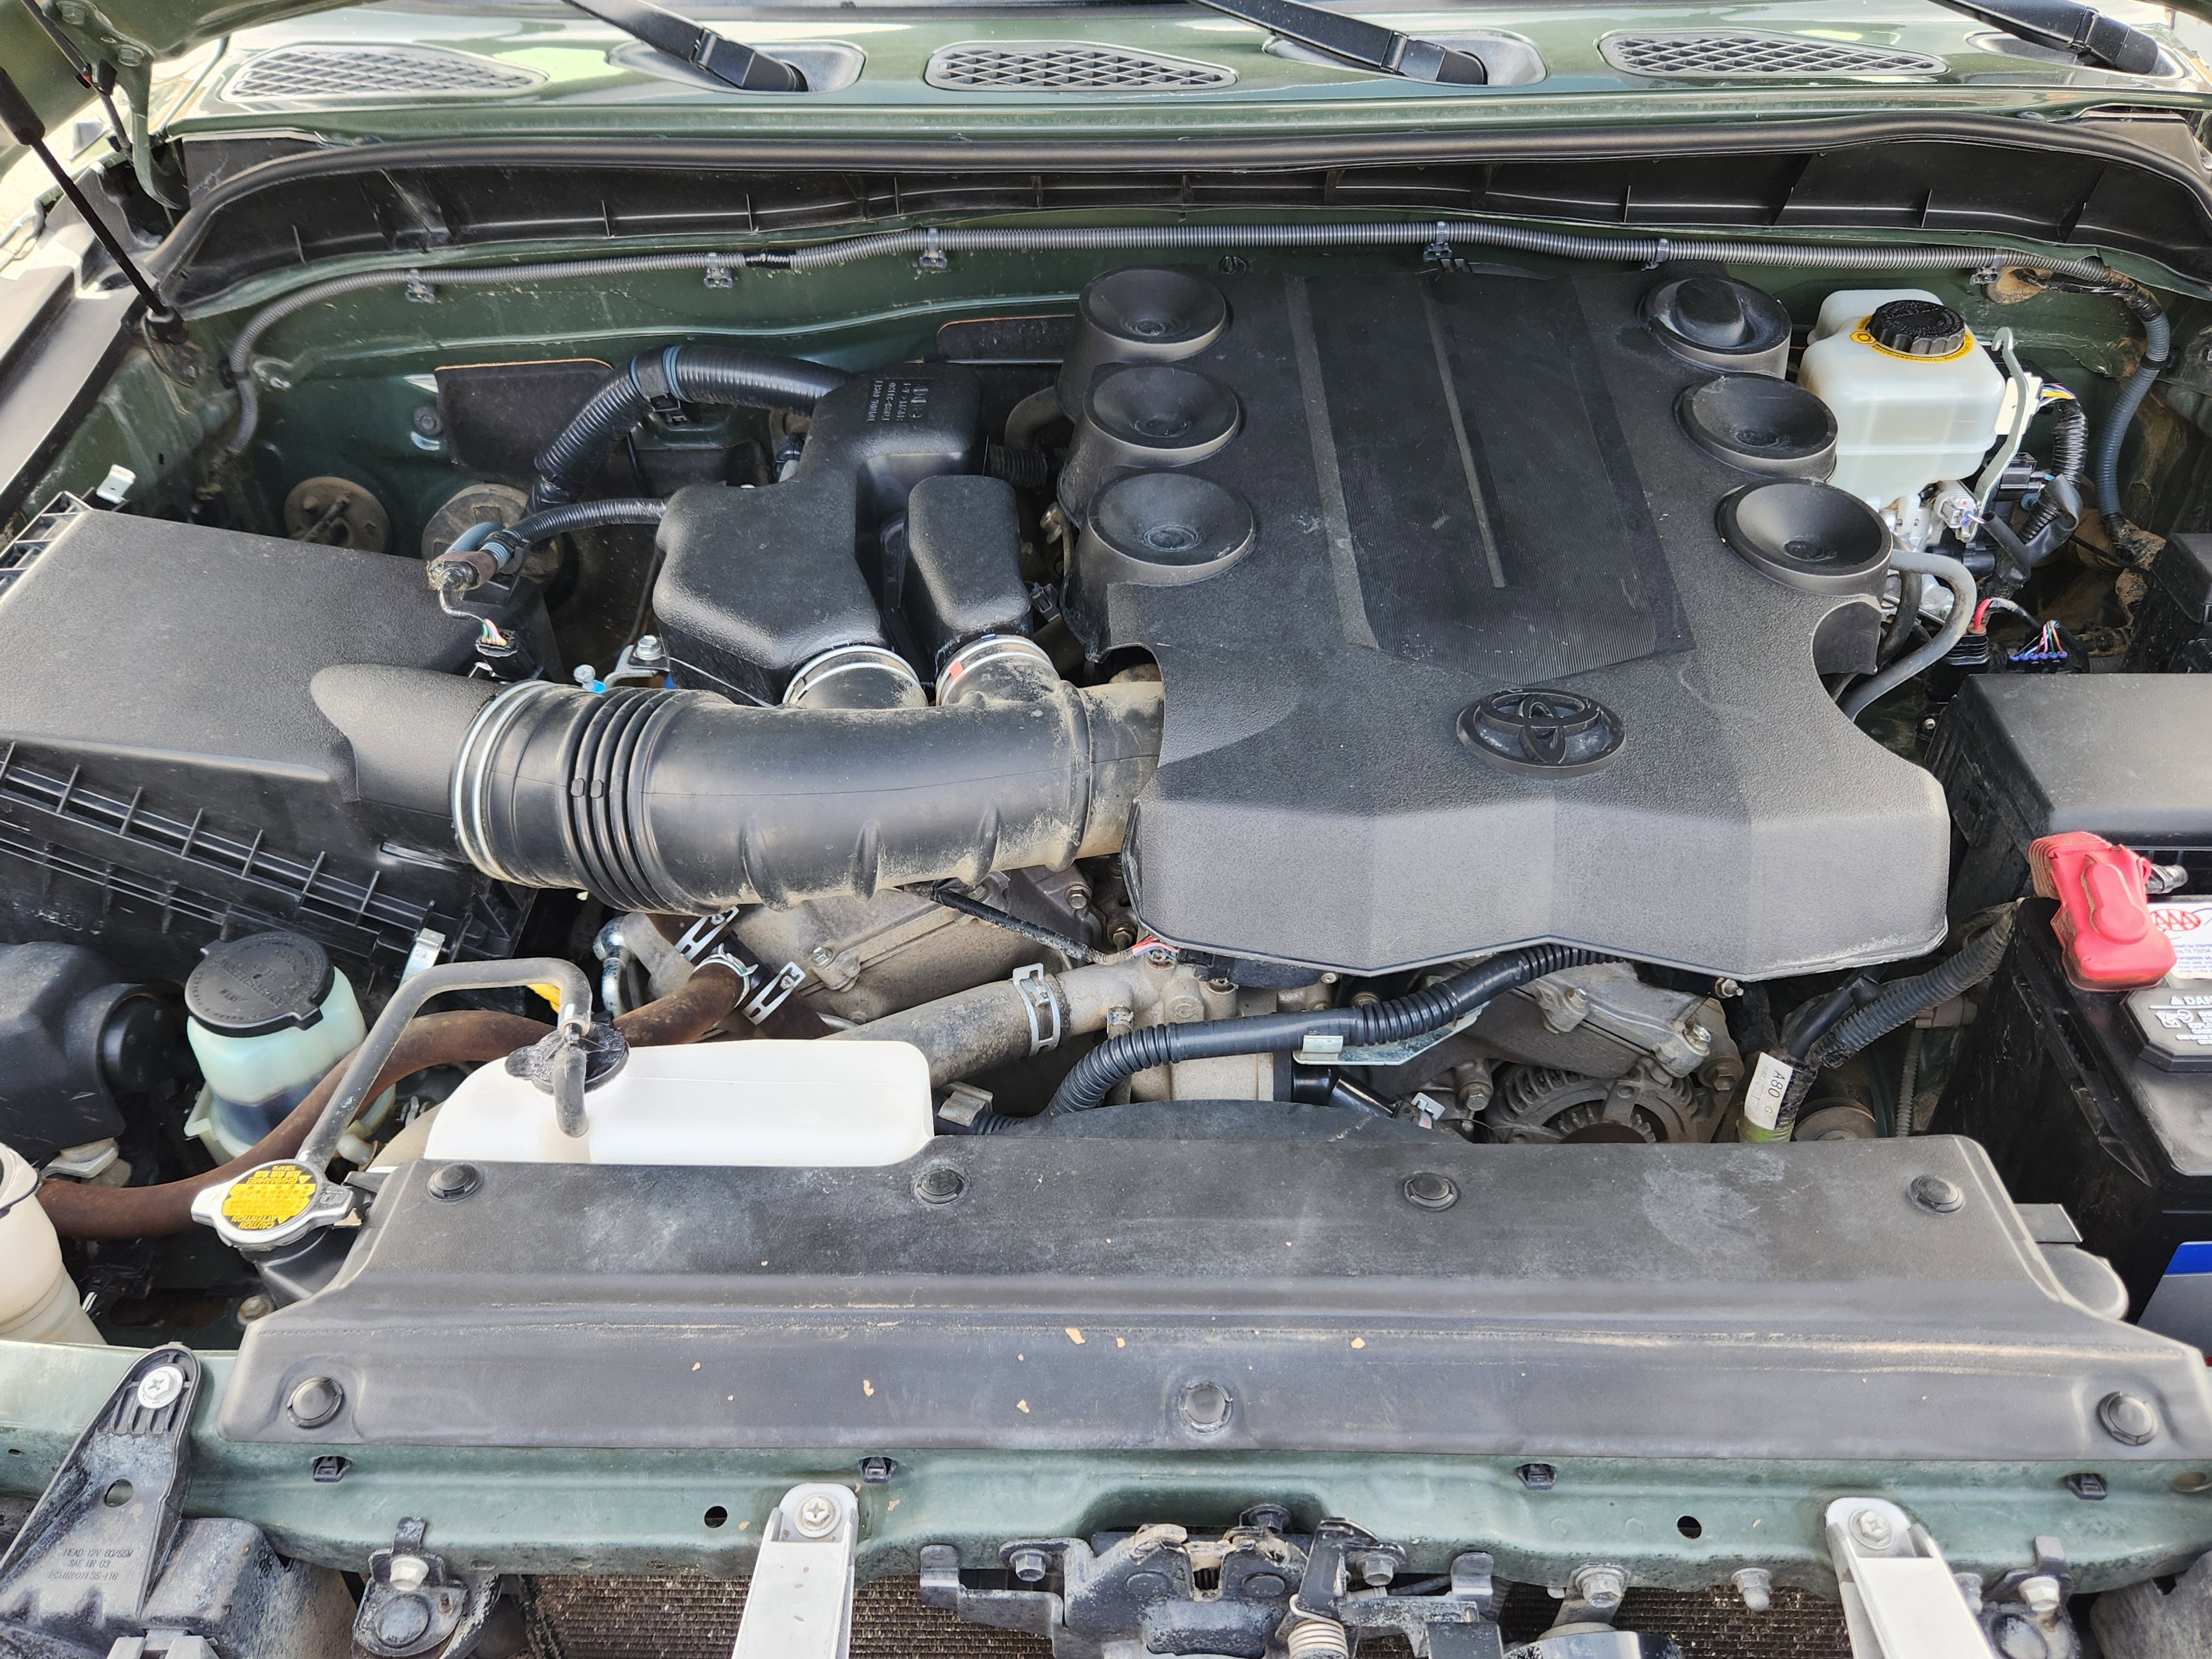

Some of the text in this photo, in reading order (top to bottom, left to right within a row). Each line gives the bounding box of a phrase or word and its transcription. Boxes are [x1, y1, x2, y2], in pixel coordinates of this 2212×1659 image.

[2153, 909, 2200, 931] AAA
[1768, 1070, 1786, 1099] A80
[238, 1221, 275, 1229] CAUTION
